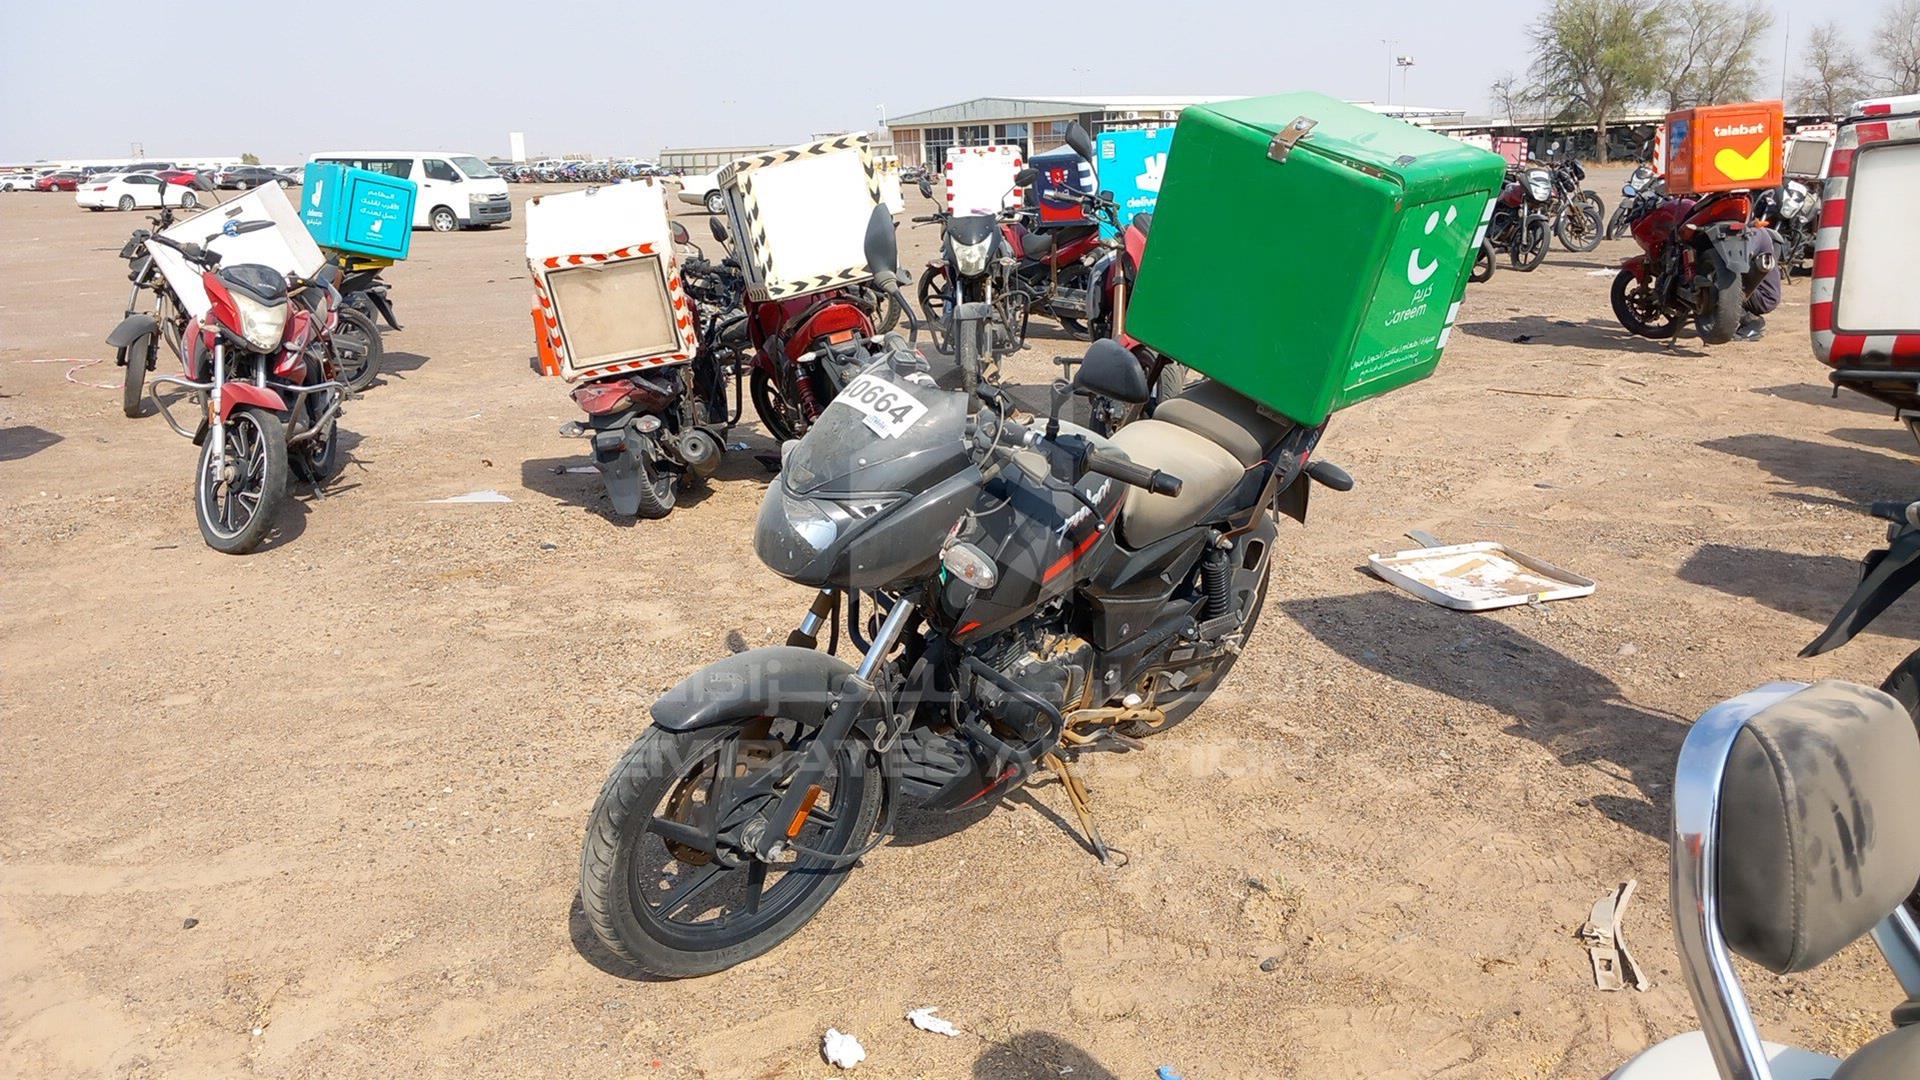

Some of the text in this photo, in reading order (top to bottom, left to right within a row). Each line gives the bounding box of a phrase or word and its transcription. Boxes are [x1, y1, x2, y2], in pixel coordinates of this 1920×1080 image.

[1713, 123, 1764, 137] talabat
[1127, 195, 1157, 209] delive
[1411, 283, 1434, 305] كريم
[1385, 303, 1427, 327] Careem
